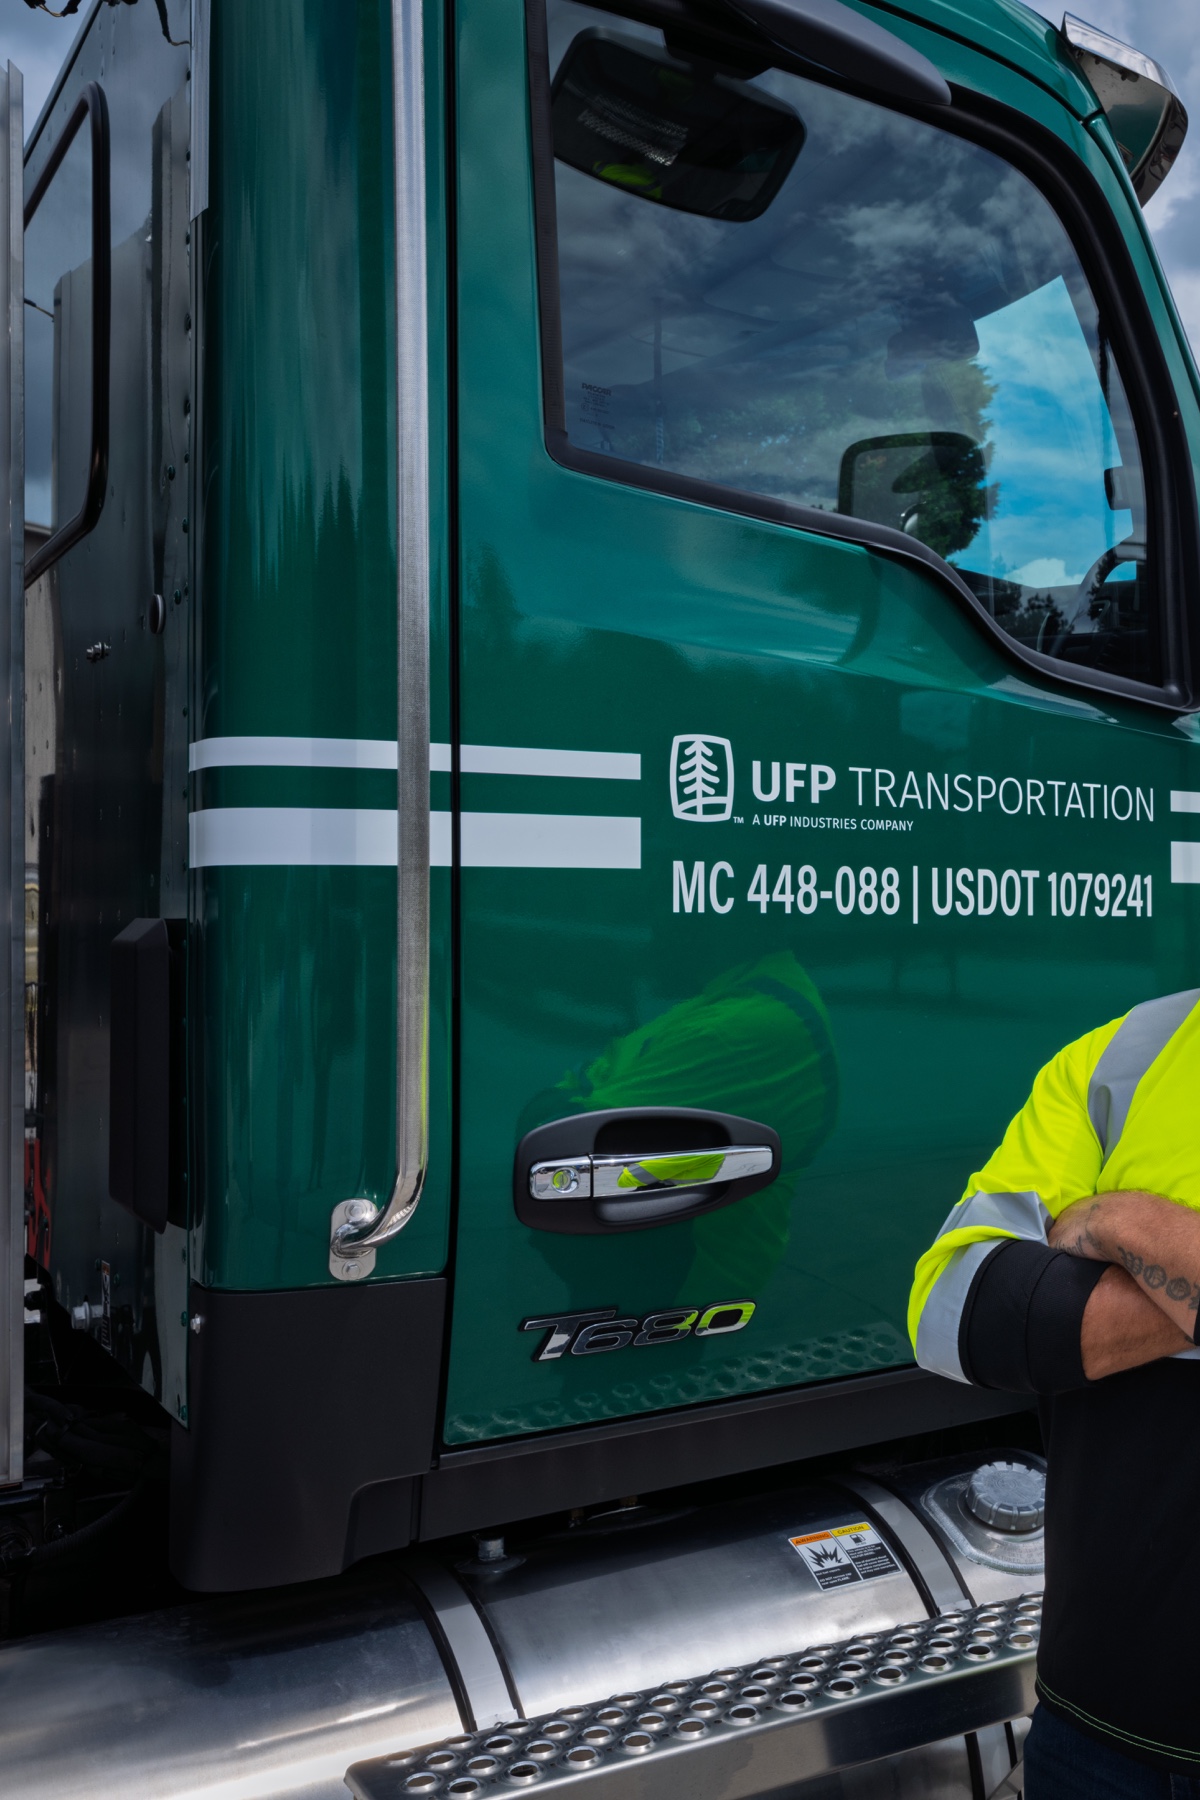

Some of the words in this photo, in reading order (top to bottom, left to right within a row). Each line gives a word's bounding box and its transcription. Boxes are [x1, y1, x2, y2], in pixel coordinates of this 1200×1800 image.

[751, 760, 837, 804] UFP
[849, 766, 1155, 822] TRANSPORTATION
[752, 813, 761, 826] A
[763, 814, 787, 827] UFP
[789, 815, 858, 830] INDUSTRIES
[860, 818, 914, 832] COMPANY
[672, 860, 735, 914] MC
[746, 863, 900, 916] 448-088
[931, 866, 1041, 917] USDOT
[1047, 872, 1154, 918] 1079241
[519, 1299, 757, 1362] T680
[837, 1525, 865, 1535] CAUTION
